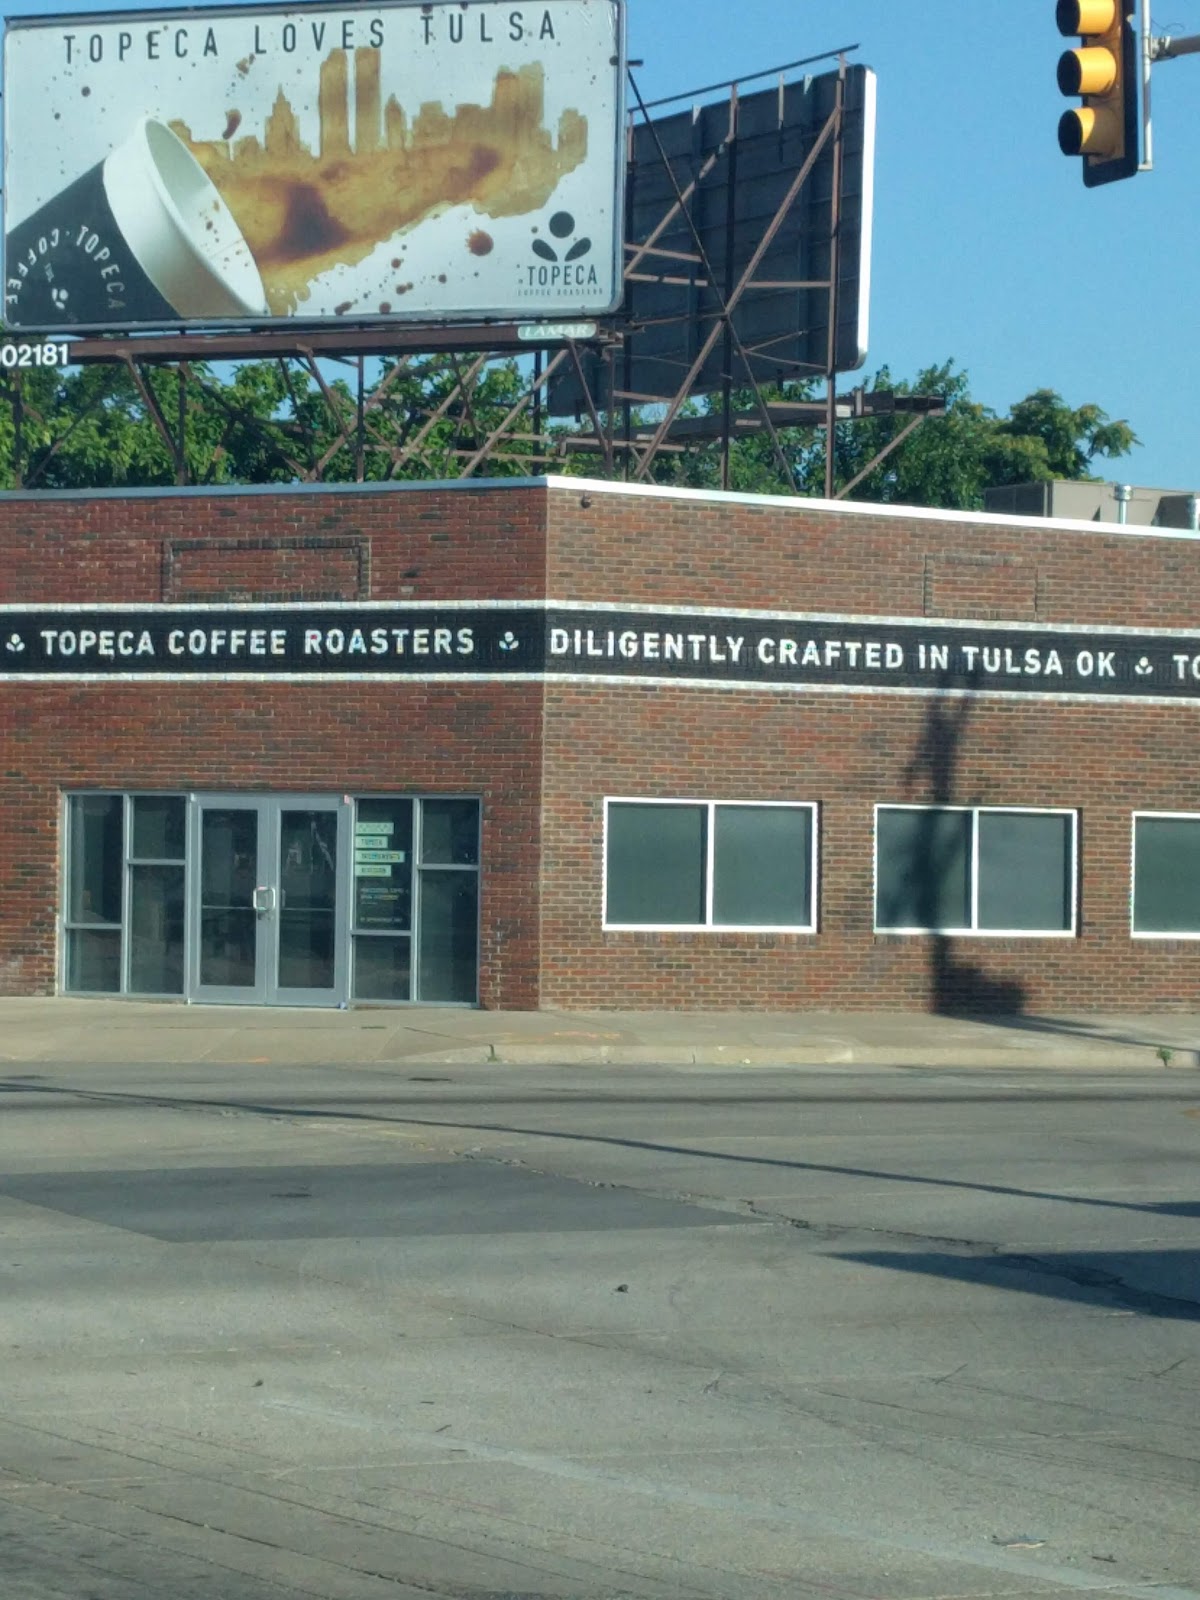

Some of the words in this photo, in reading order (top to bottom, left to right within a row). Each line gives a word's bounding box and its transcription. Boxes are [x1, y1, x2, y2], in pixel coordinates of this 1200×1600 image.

[63, 26, 218, 64] TOPECA
[254, 17, 385, 54] LOVES
[420, 9, 556, 45] TULSA
[76, 224, 126, 309] TOPECA
[527, 264, 598, 286] TOPECA
[40, 629, 155, 656] TOPECA
[168, 628, 287, 655] COFFEE
[304, 628, 474, 655] ROASTERS
[550, 628, 745, 662] DILIGENTLY
[757, 637, 904, 669] CRAFTED
[918, 644, 949, 670] IN
[962, 645, 1064, 676] TULSA
[1076, 650, 1117, 677] OK
